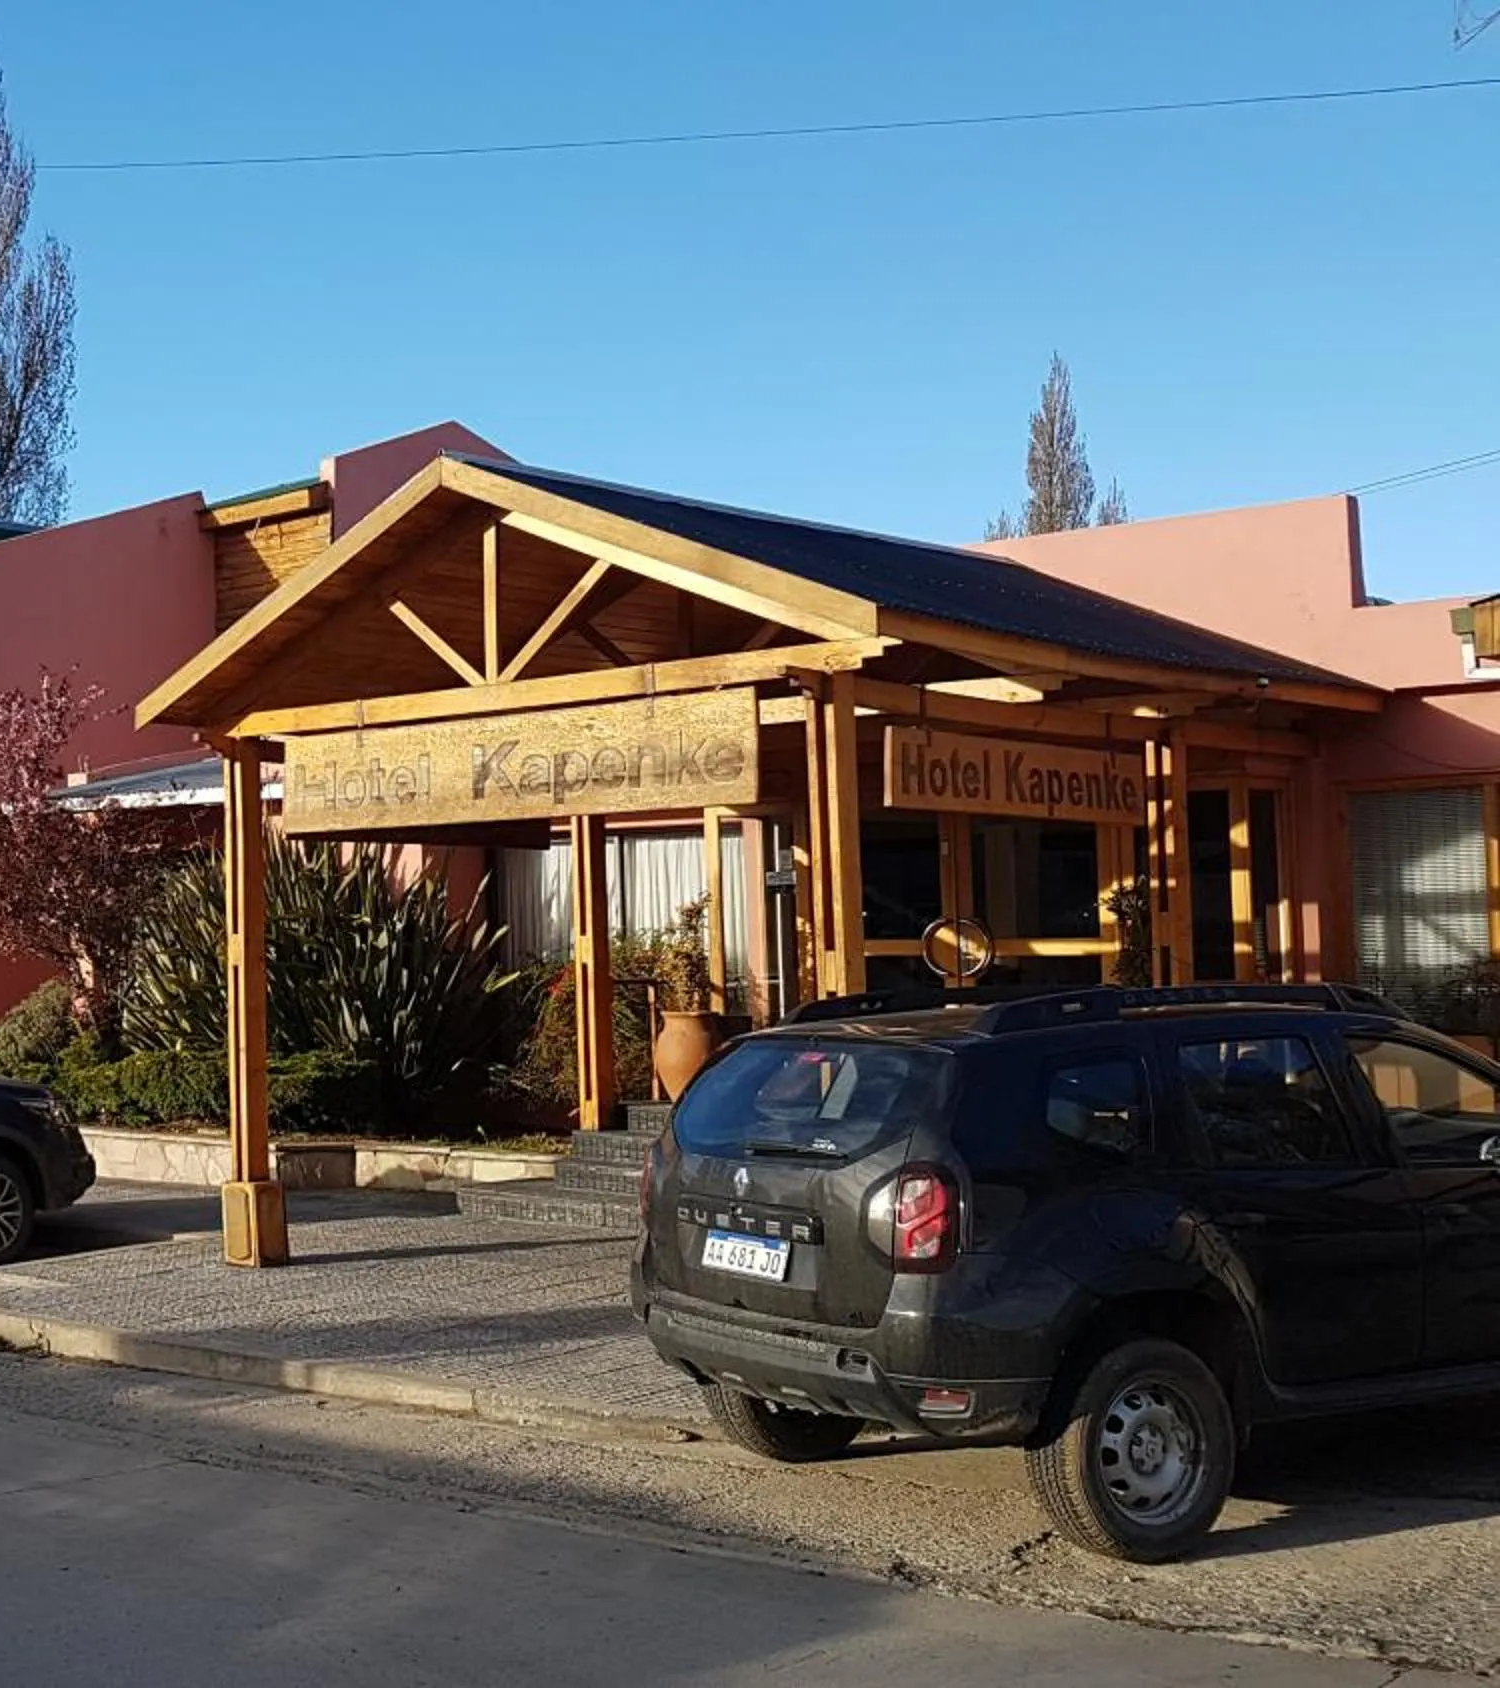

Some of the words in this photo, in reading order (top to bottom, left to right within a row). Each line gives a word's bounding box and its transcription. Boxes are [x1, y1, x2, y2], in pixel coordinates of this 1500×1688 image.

[293, 751, 431, 813] Hotel
[471, 729, 746, 805] Kapenke
[900, 740, 992, 801] Hotel
[1004, 750, 1139, 818] Kapenke
[676, 1206, 810, 1241] DUSTER
[727, 1244, 757, 1270] 681
